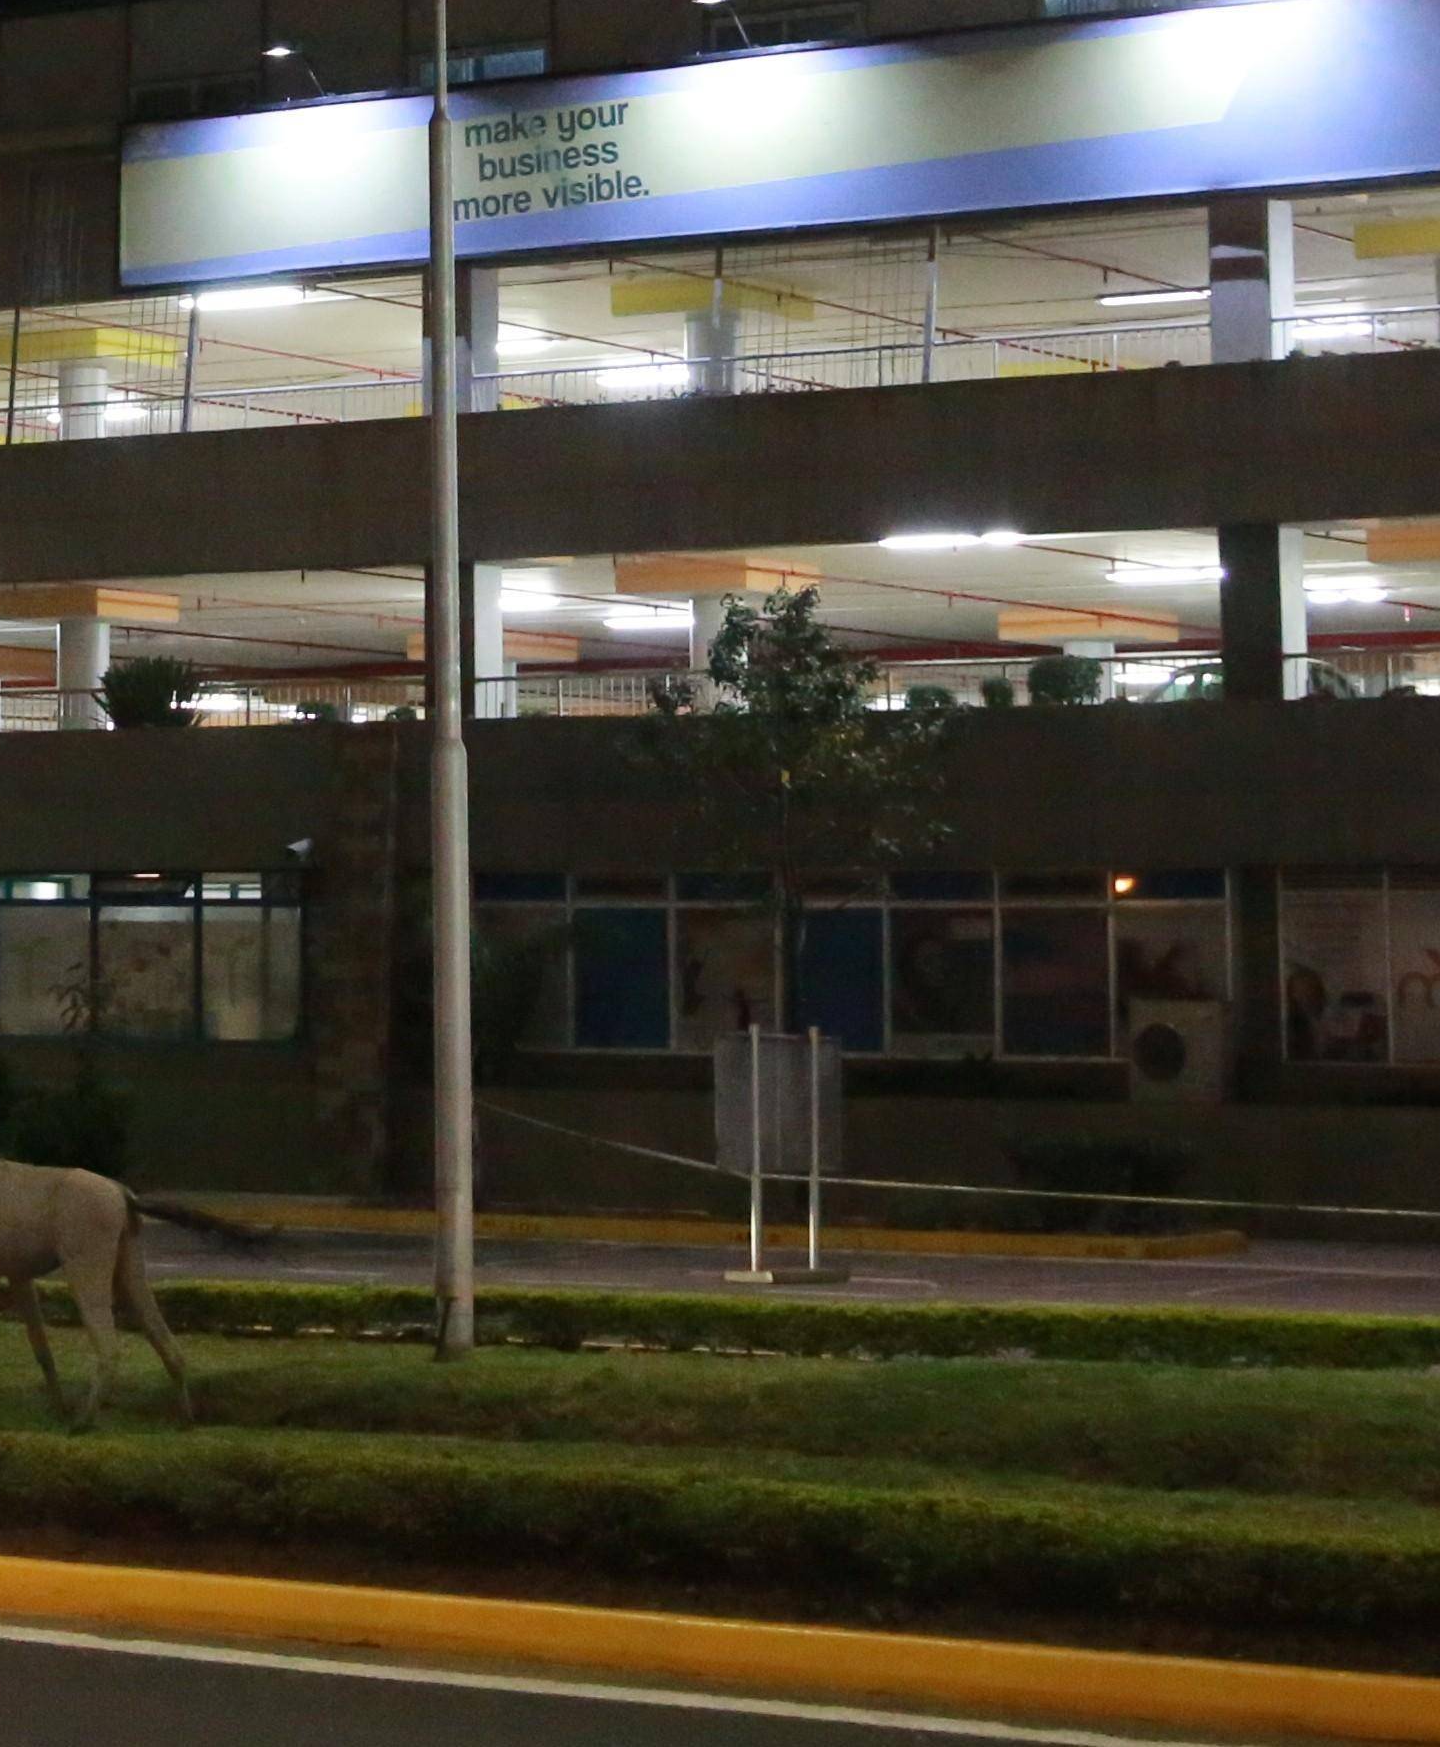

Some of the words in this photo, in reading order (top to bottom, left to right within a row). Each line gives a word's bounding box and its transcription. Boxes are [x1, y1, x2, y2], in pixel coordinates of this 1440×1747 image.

[465, 112, 546, 148] make
[557, 103, 629, 143] your
[478, 140, 619, 182] business
[453, 189, 532, 221] more
[542, 170, 650, 209] visible.
